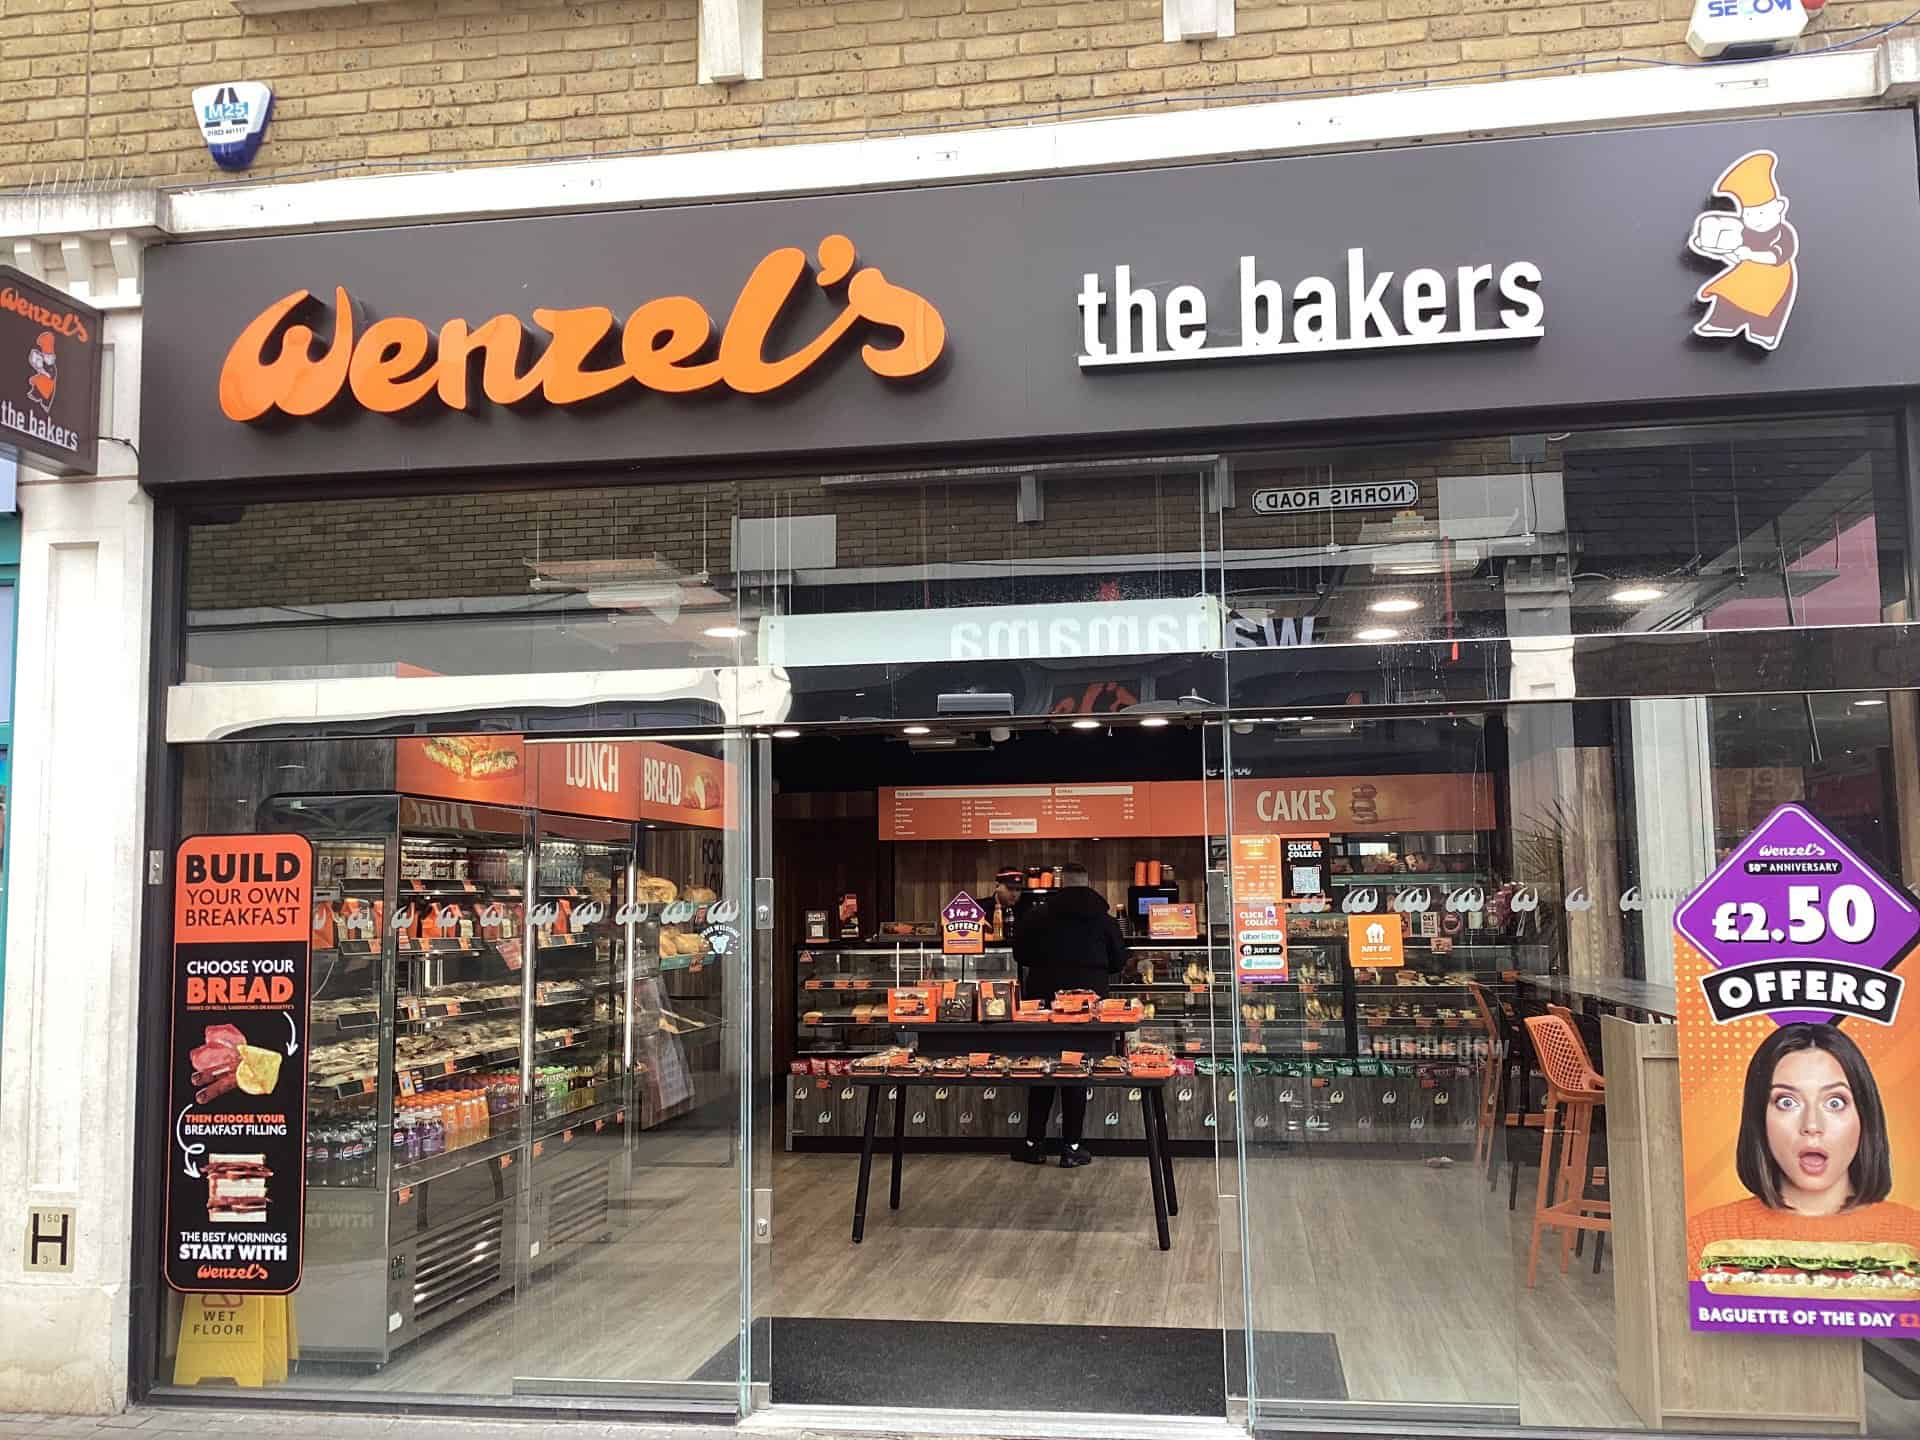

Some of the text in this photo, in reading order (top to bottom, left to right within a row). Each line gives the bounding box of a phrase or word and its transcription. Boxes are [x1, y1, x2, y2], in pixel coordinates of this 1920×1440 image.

[208, 103, 246, 120] M25
[1077, 248, 1545, 357] the bakers
[0, 287, 89, 343] Wenzel's
[218, 235, 946, 422] Wenzel's
[1, 401, 80, 450] the bakers
[566, 743, 620, 793] LUNCH
[644, 758, 682, 806] BREAD
[1256, 789, 1337, 821] CAKES
[1759, 843, 1825, 857] Wenzel's
[185, 852, 301, 884] BUILD
[1769, 863, 1838, 872] ANNIVERSARY
[186, 887, 301, 905] YOUR OWN
[185, 907, 300, 927] BREAKFAST
[971, 908, 978, 918] 2
[1712, 884, 1876, 944] £2.50
[948, 922, 979, 931] OFFERS
[186, 959, 295, 975] CHOOSE YOUR
[186, 976, 295, 1004] BREAD
[1718, 969, 1888, 1011] OFFERS
[185, 1114, 286, 1124] THEN CHOOSE YOUR
[184, 1124, 287, 1136] BREAKFAST FILLING
[31, 1213, 69, 1266] H
[180, 1232, 288, 1244] THE BEST MORNINGS
[179, 1244, 288, 1262] START WITH
[197, 1264, 269, 1280] Wenzel's
[203, 1311, 237, 1322] WET
[1698, 1307, 1789, 1325] BAGUETTE
[1792, 1310, 1817, 1325] OF
[1820, 1312, 1856, 1326] THE
[1859, 1312, 1895, 1327] DAY
[193, 1324, 245, 1336] FLOOR
